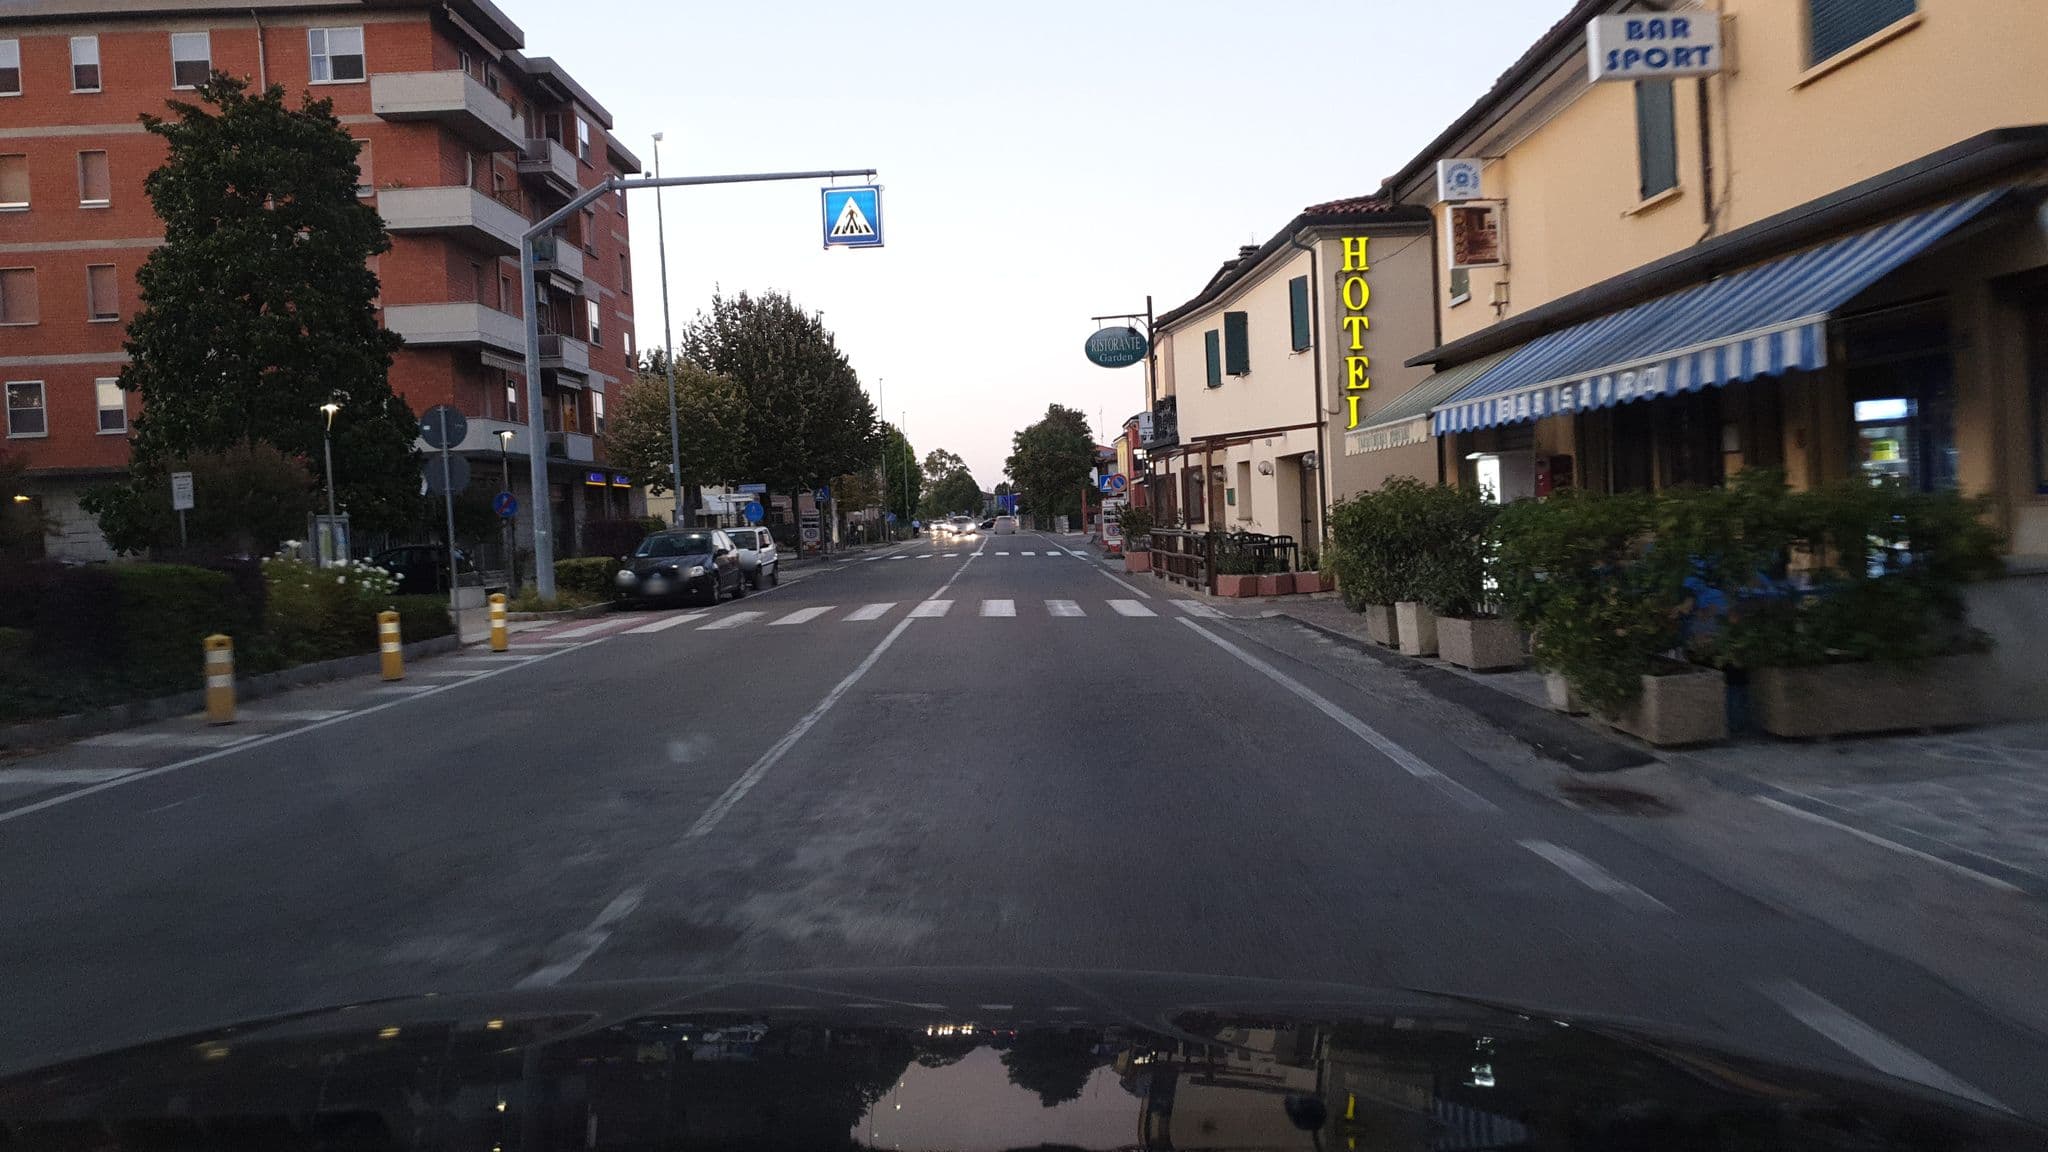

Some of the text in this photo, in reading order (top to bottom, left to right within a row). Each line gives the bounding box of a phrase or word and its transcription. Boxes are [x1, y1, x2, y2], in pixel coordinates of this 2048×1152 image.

[1625, 18, 1690, 40] BAR
[1606, 44, 1713, 70] SPORT
[1091, 336, 1141, 352] RISTORANTE
[1100, 353, 1133, 362] Garden
